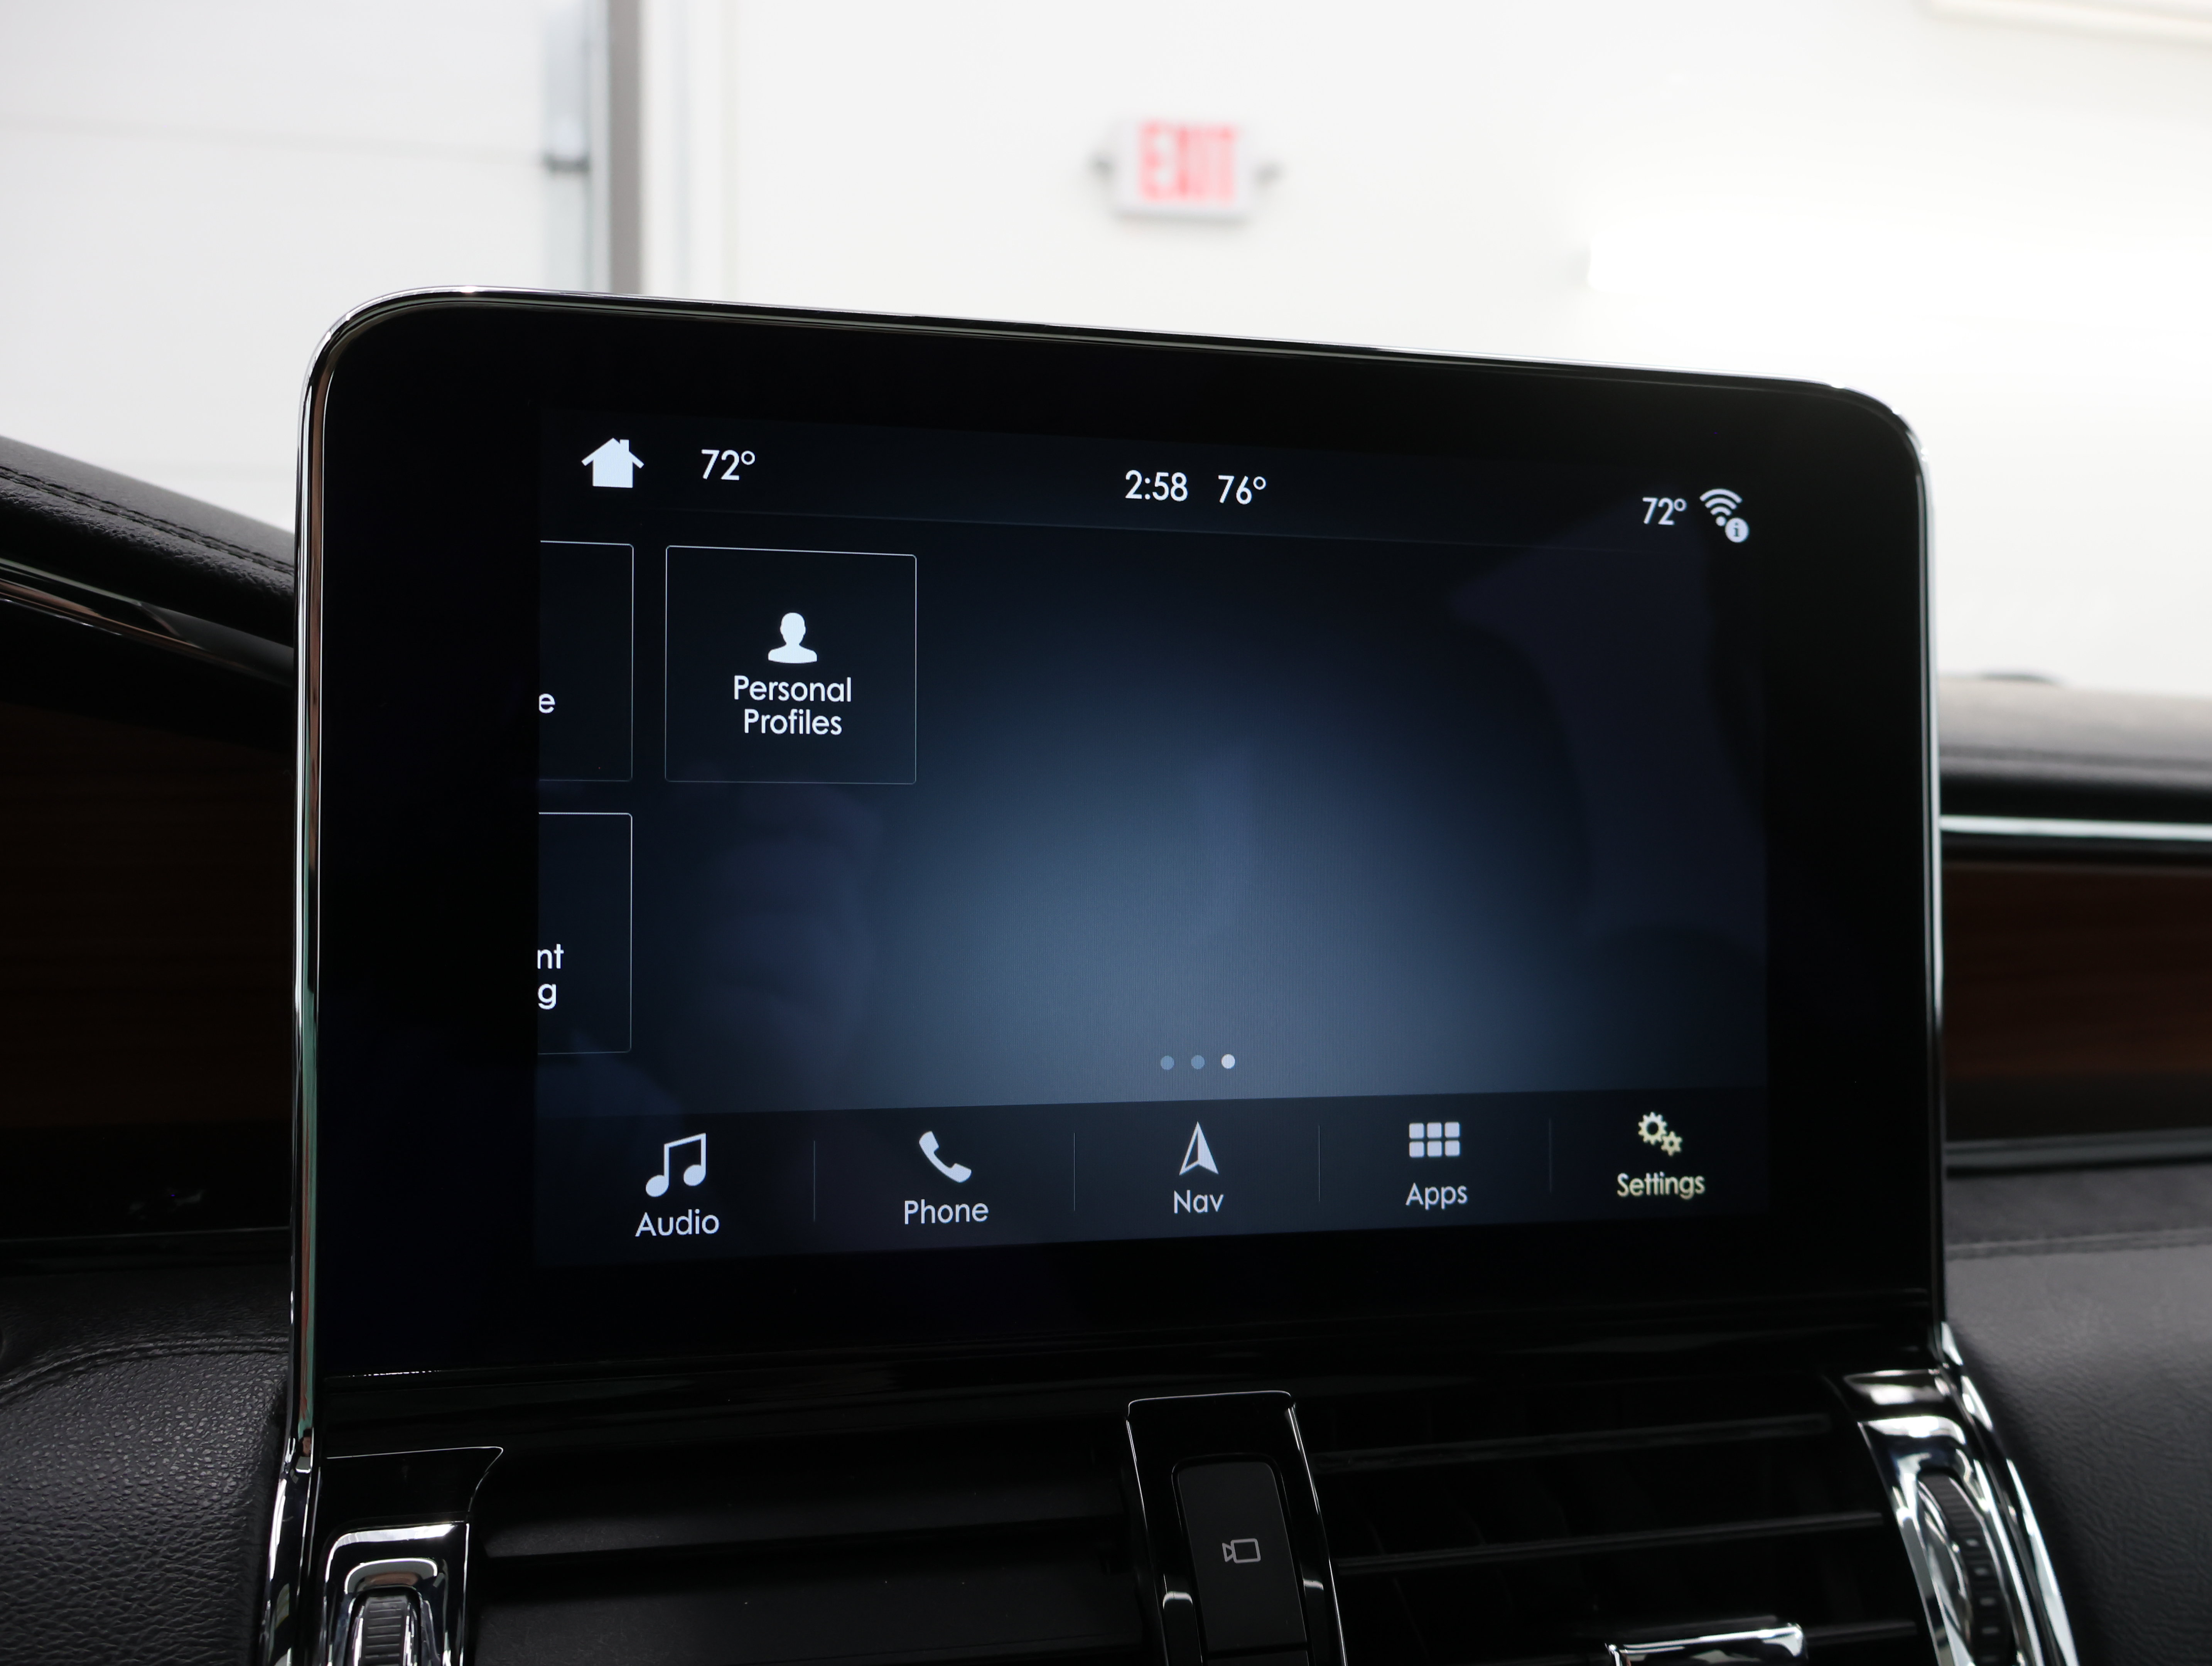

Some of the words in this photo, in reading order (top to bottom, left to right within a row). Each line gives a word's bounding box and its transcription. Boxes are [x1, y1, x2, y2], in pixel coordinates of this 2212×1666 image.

[1139, 120, 1237, 203] EXIT
[1124, 469, 1189, 502] 2:58
[733, 674, 852, 703] Personal
[744, 708, 843, 736] Profiles
[1405, 1182, 1468, 1211] Apps
[1616, 1171, 1705, 1199] Settings
[904, 1198, 989, 1225] Phone
[1173, 1189, 1224, 1214] Nav
[634, 1208, 720, 1238] Audio
